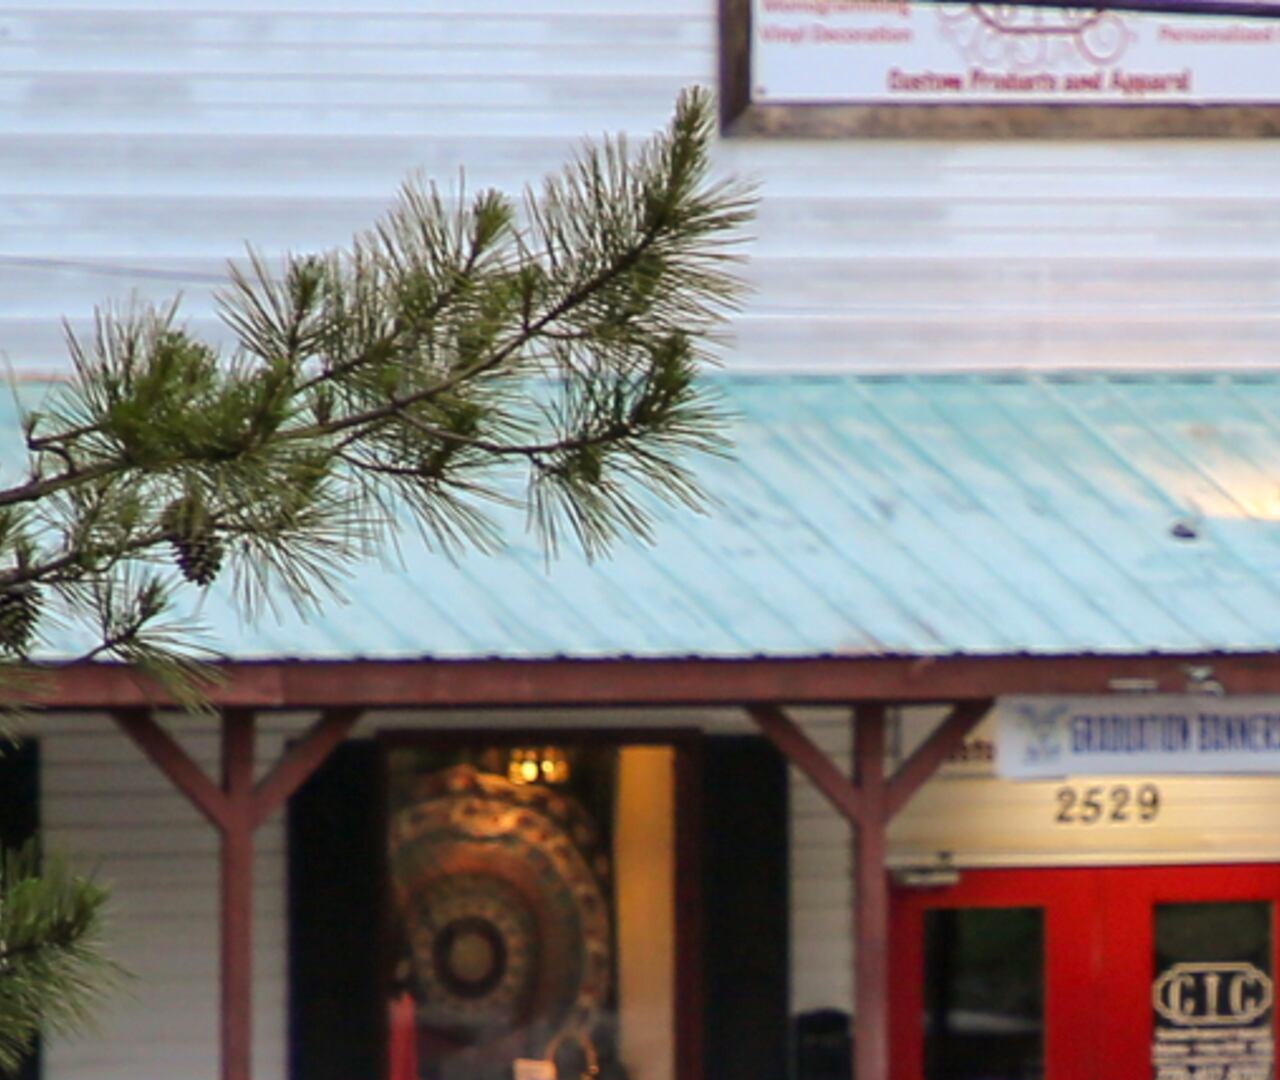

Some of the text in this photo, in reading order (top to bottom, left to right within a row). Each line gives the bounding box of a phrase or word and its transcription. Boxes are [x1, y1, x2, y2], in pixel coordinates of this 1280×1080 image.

[888, 67, 1191, 93] Custom Products and Apparel
[1071, 714, 1191, 752] GRADUATION
[1054, 784, 1161, 824] 2529
[1168, 973, 1258, 1017] CIC
